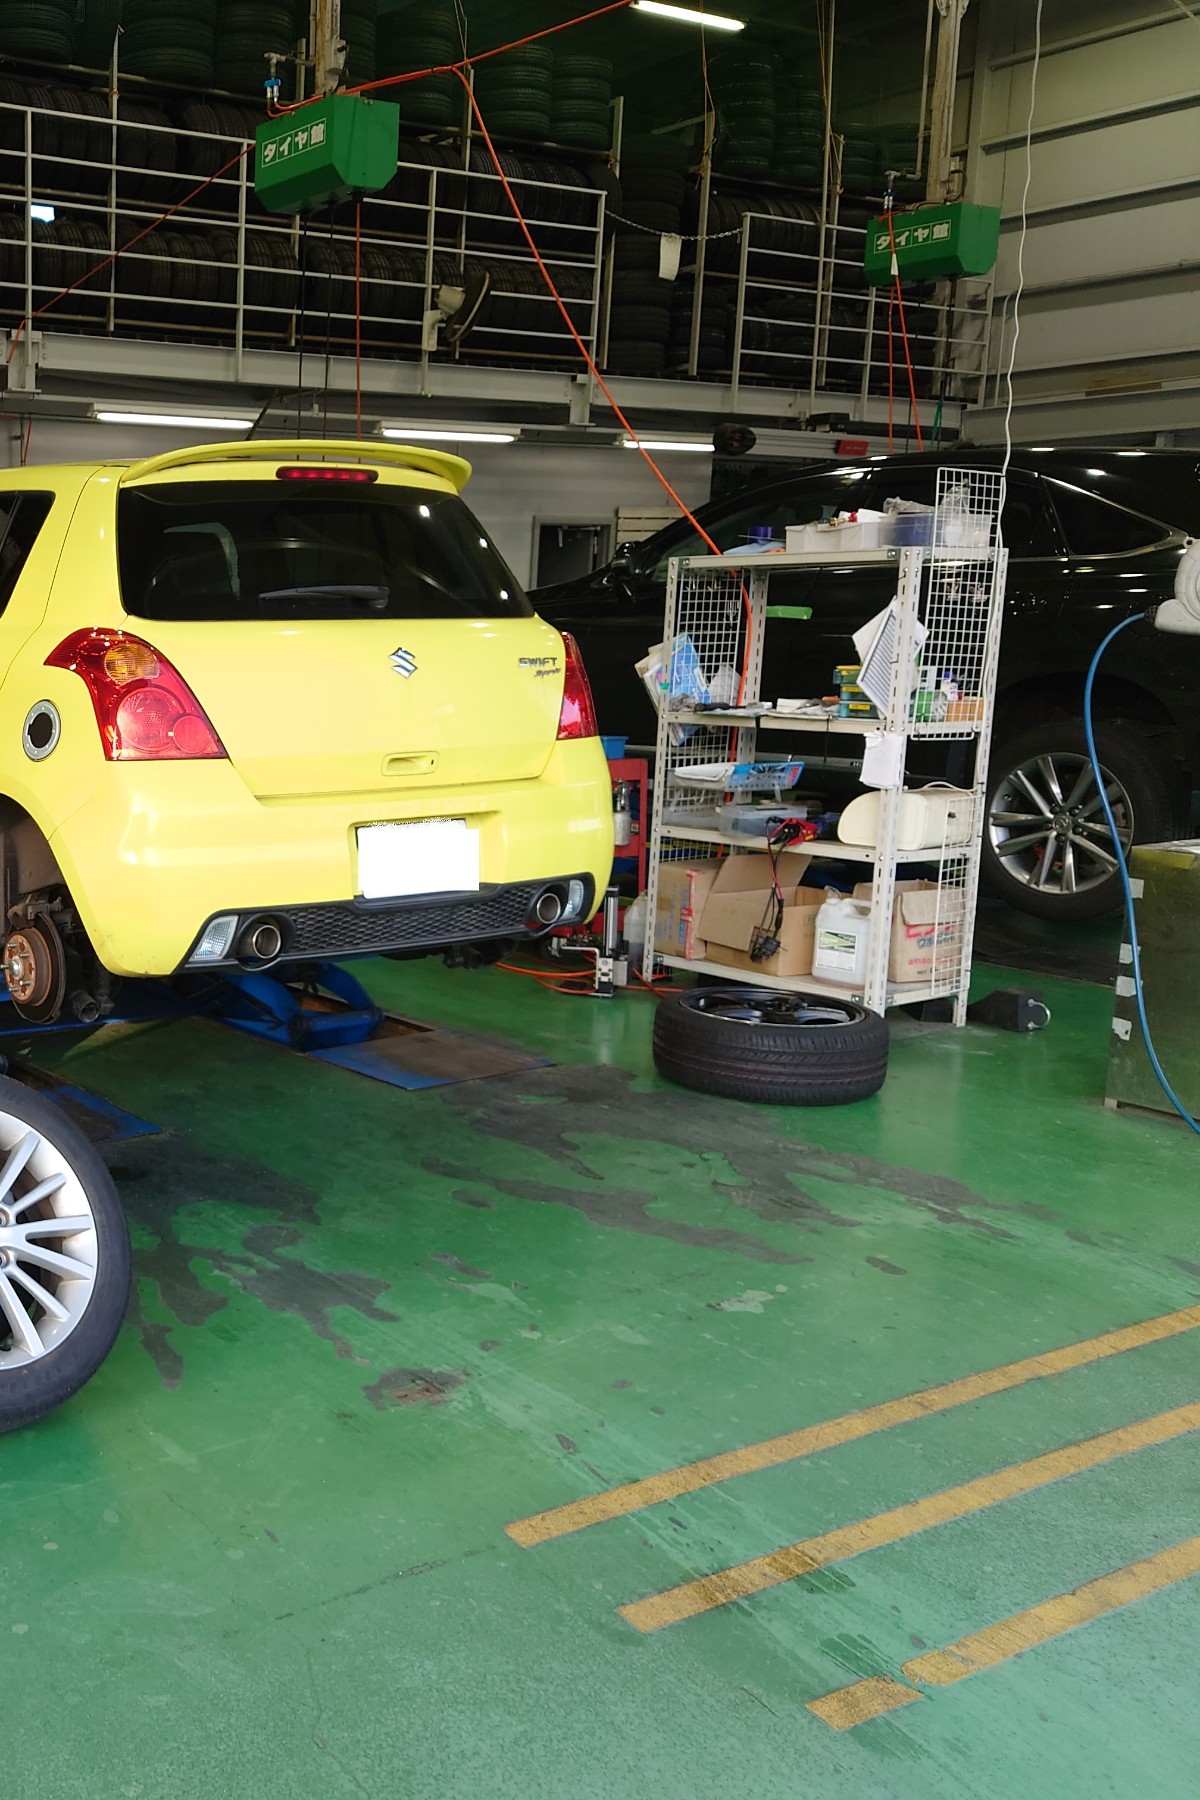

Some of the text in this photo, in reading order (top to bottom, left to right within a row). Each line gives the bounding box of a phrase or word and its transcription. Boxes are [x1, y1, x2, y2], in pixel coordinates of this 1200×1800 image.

[264, 123, 325, 163] タイヤ館
[876, 223, 949, 250] タイヤ館
[519, 657, 557, 667] SWIFT
